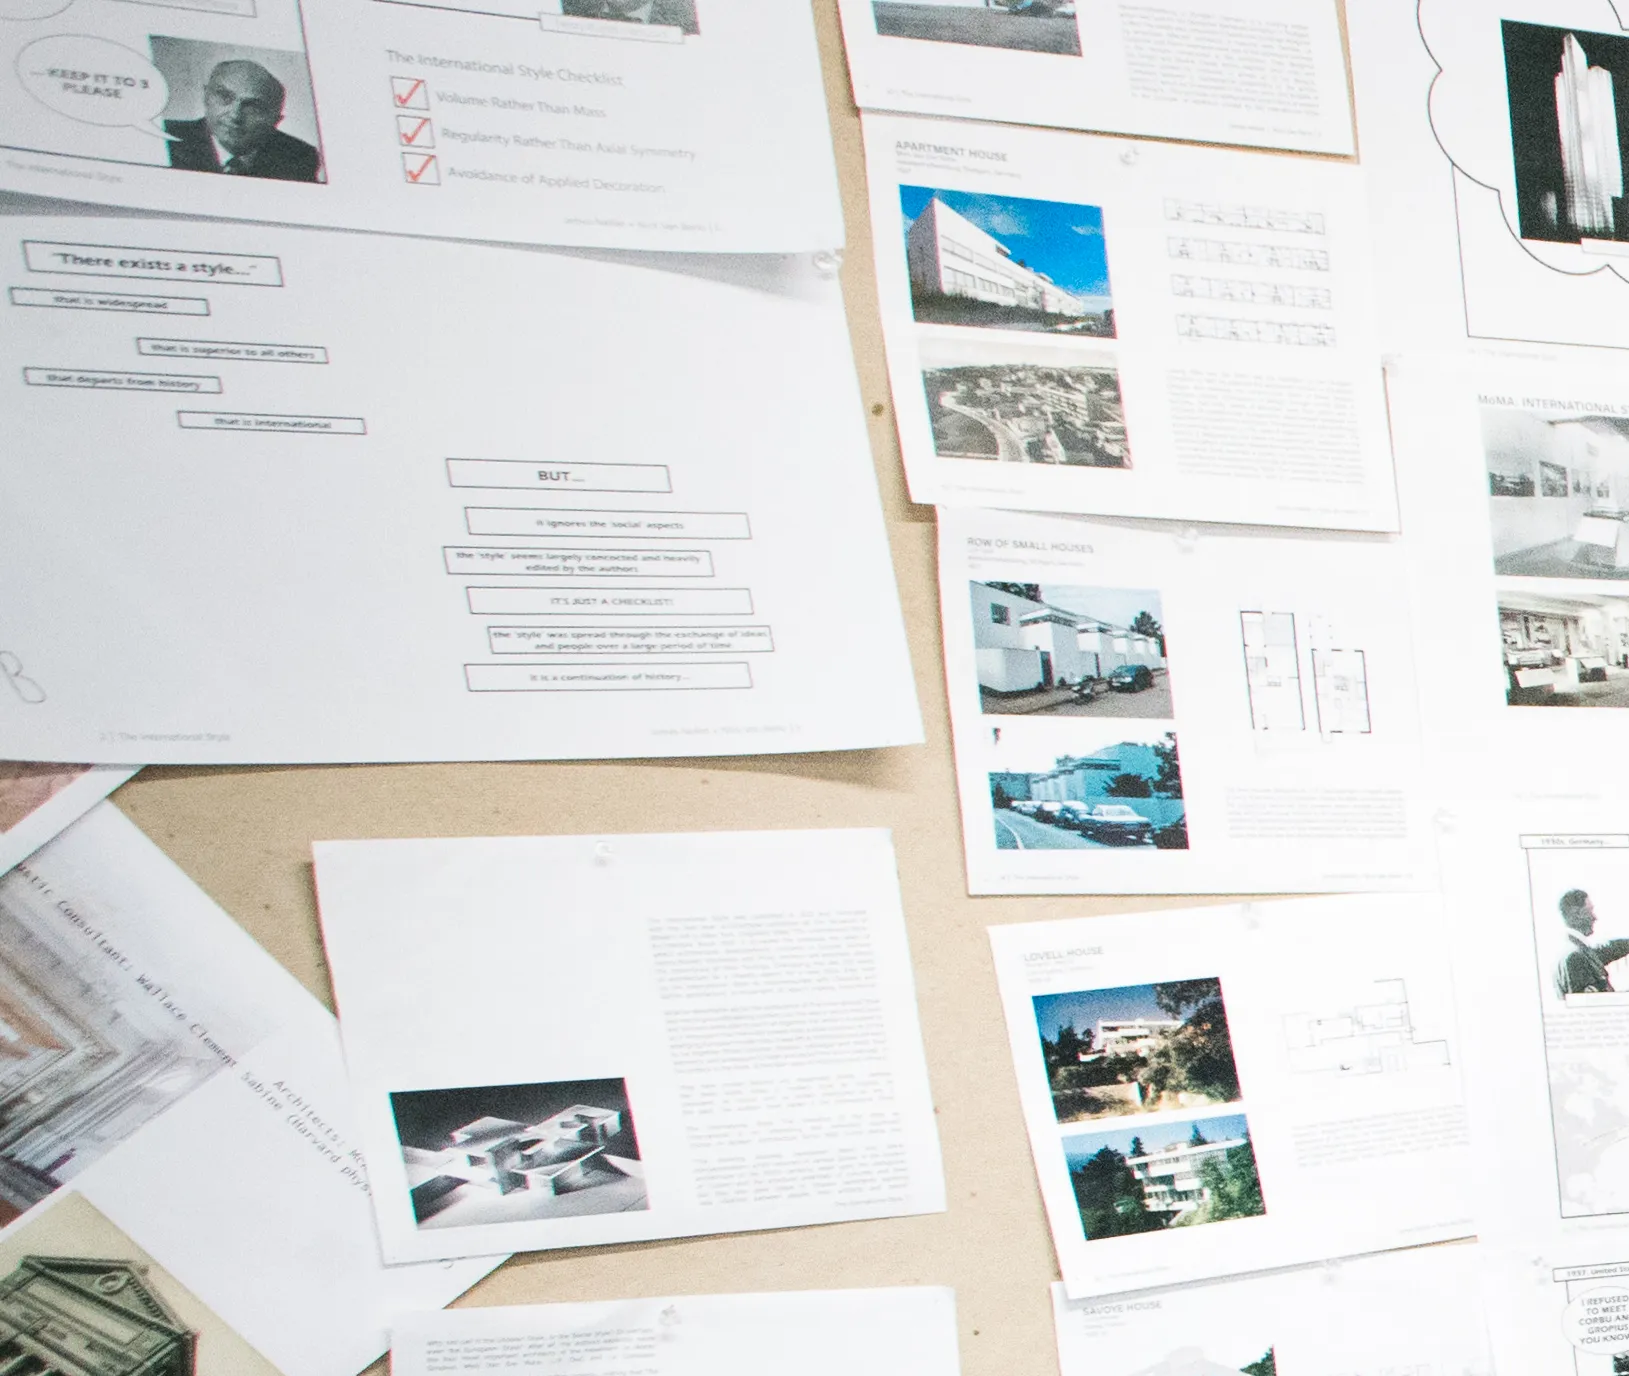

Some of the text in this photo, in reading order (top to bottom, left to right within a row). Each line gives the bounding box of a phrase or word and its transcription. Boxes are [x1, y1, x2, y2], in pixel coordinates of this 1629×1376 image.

[386, 50, 624, 86] The International Style Checklist
[62, 81, 122, 99] PLEASE
[113, 75, 135, 88] TO
[436, 90, 606, 118] Volume Rather Than Mass
[441, 127, 696, 161] Regularity Rather Than Axial Symmetry
[895, 140, 1008, 162] APARTMENT HOUSE
[448, 167, 666, 194] Avoidance of Applied Decoration
[118, 256, 172, 271] exists
[176, 262, 188, 272] a
[97, 297, 169, 311] widespread
[158, 378, 201, 392] history
[1521, 397, 1618, 415] INTERNATIONAL
[967, 536, 1094, 554] ROW OF SMALL HOUSES
[1023, 945, 1104, 962] LOVELL HOUSE
[136, 974, 187, 1022] Wallace
[189, 1023, 238, 1068] Clement
[240, 1070, 283, 1112] Sabine
[286, 1112, 341, 1164] (Harvard
[273, 1078, 345, 1149] Architects:
[1083, 1300, 1162, 1316] SAVOYE HOUSE
[1587, 1294, 1629, 1306] REFUSED
[1602, 1304, 1627, 1315] MEET
[1578, 1315, 1613, 1326] CORBU
[1587, 1324, 1629, 1335] GROPIUS
[1580, 1336, 1599, 1345] YOU
